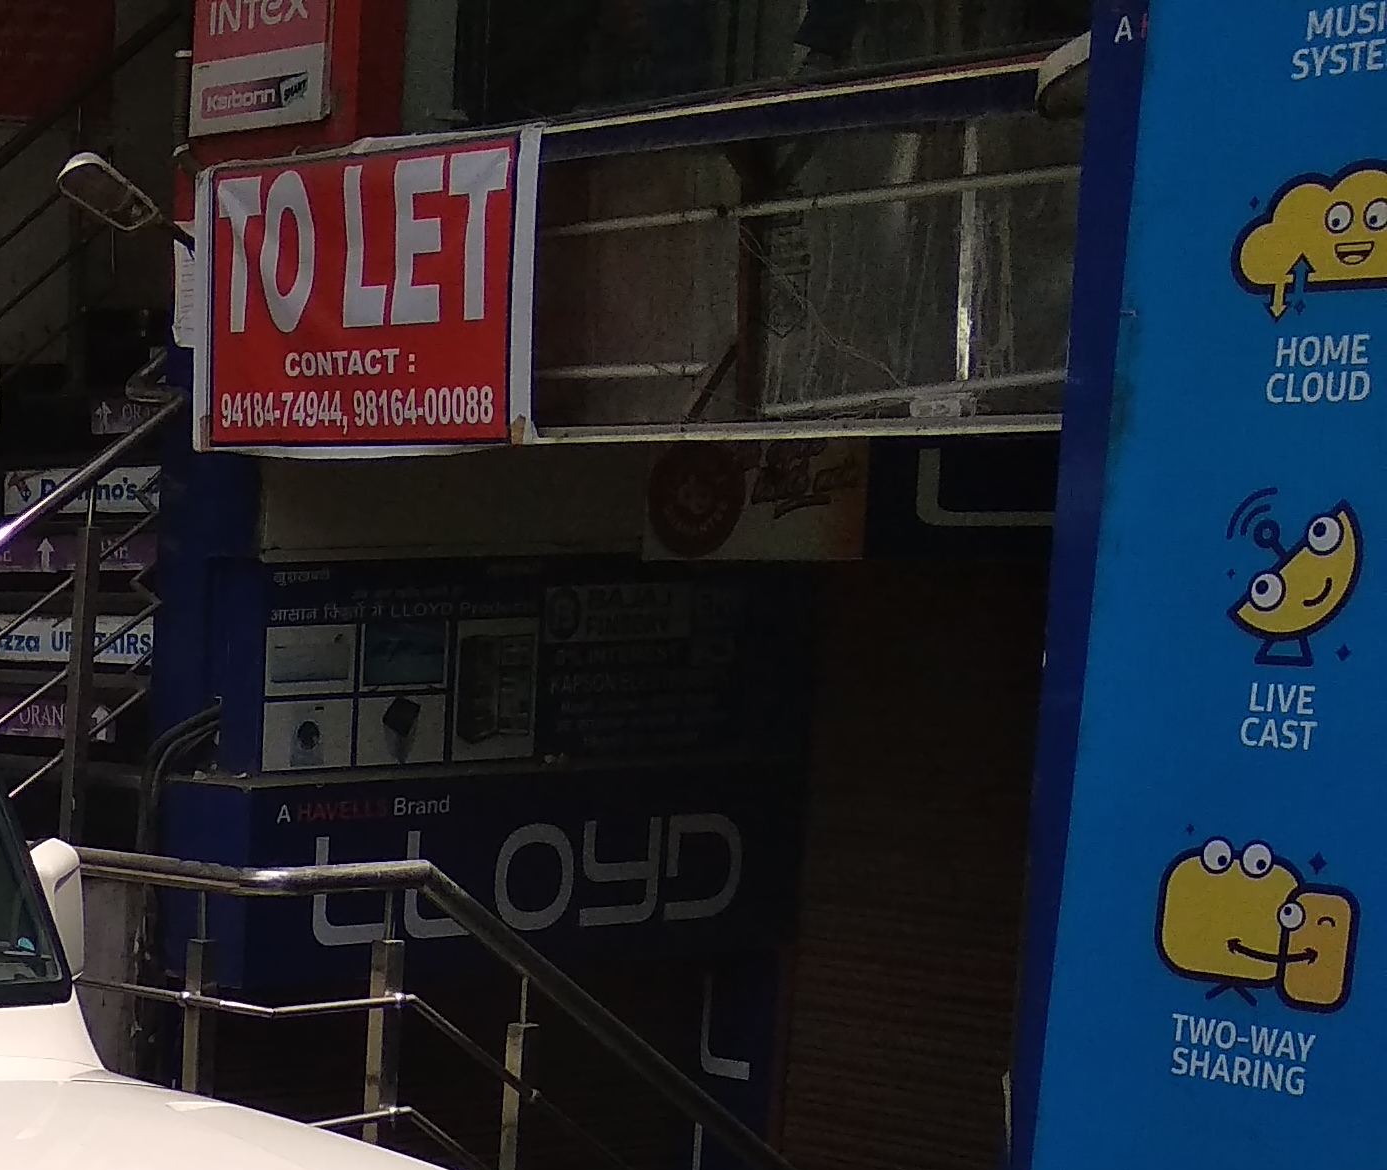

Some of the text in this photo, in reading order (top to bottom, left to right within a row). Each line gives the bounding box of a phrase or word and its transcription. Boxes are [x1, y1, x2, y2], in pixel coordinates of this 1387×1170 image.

[1114, 15, 1134, 44] A
[206, 87, 276, 113] Karbonn
[217, 169, 316, 334] TO
[341, 147, 512, 329] LET
[285, 348, 396, 377] CONTACT
[1275, 334, 1369, 369] HOME
[1266, 370, 1372, 404] CLOUD
[219, 385, 494, 434] 94184-74944, 98164-00088
[40, 477, 137, 502] Dno's
[390, 602, 454, 619] LLOYD
[93, 633, 151, 655] TAIRS
[1249, 681, 1317, 716] LIVE
[18, 703, 66, 729] ORAN
[1240, 715, 1319, 750] CAST
[276, 794, 452, 825] A HAVELLS Brand
[312, 812, 742, 948] LLOYD
[1172, 1014, 1316, 1063] TWO-WAY
[1171, 1048, 1306, 1095] SHARING
